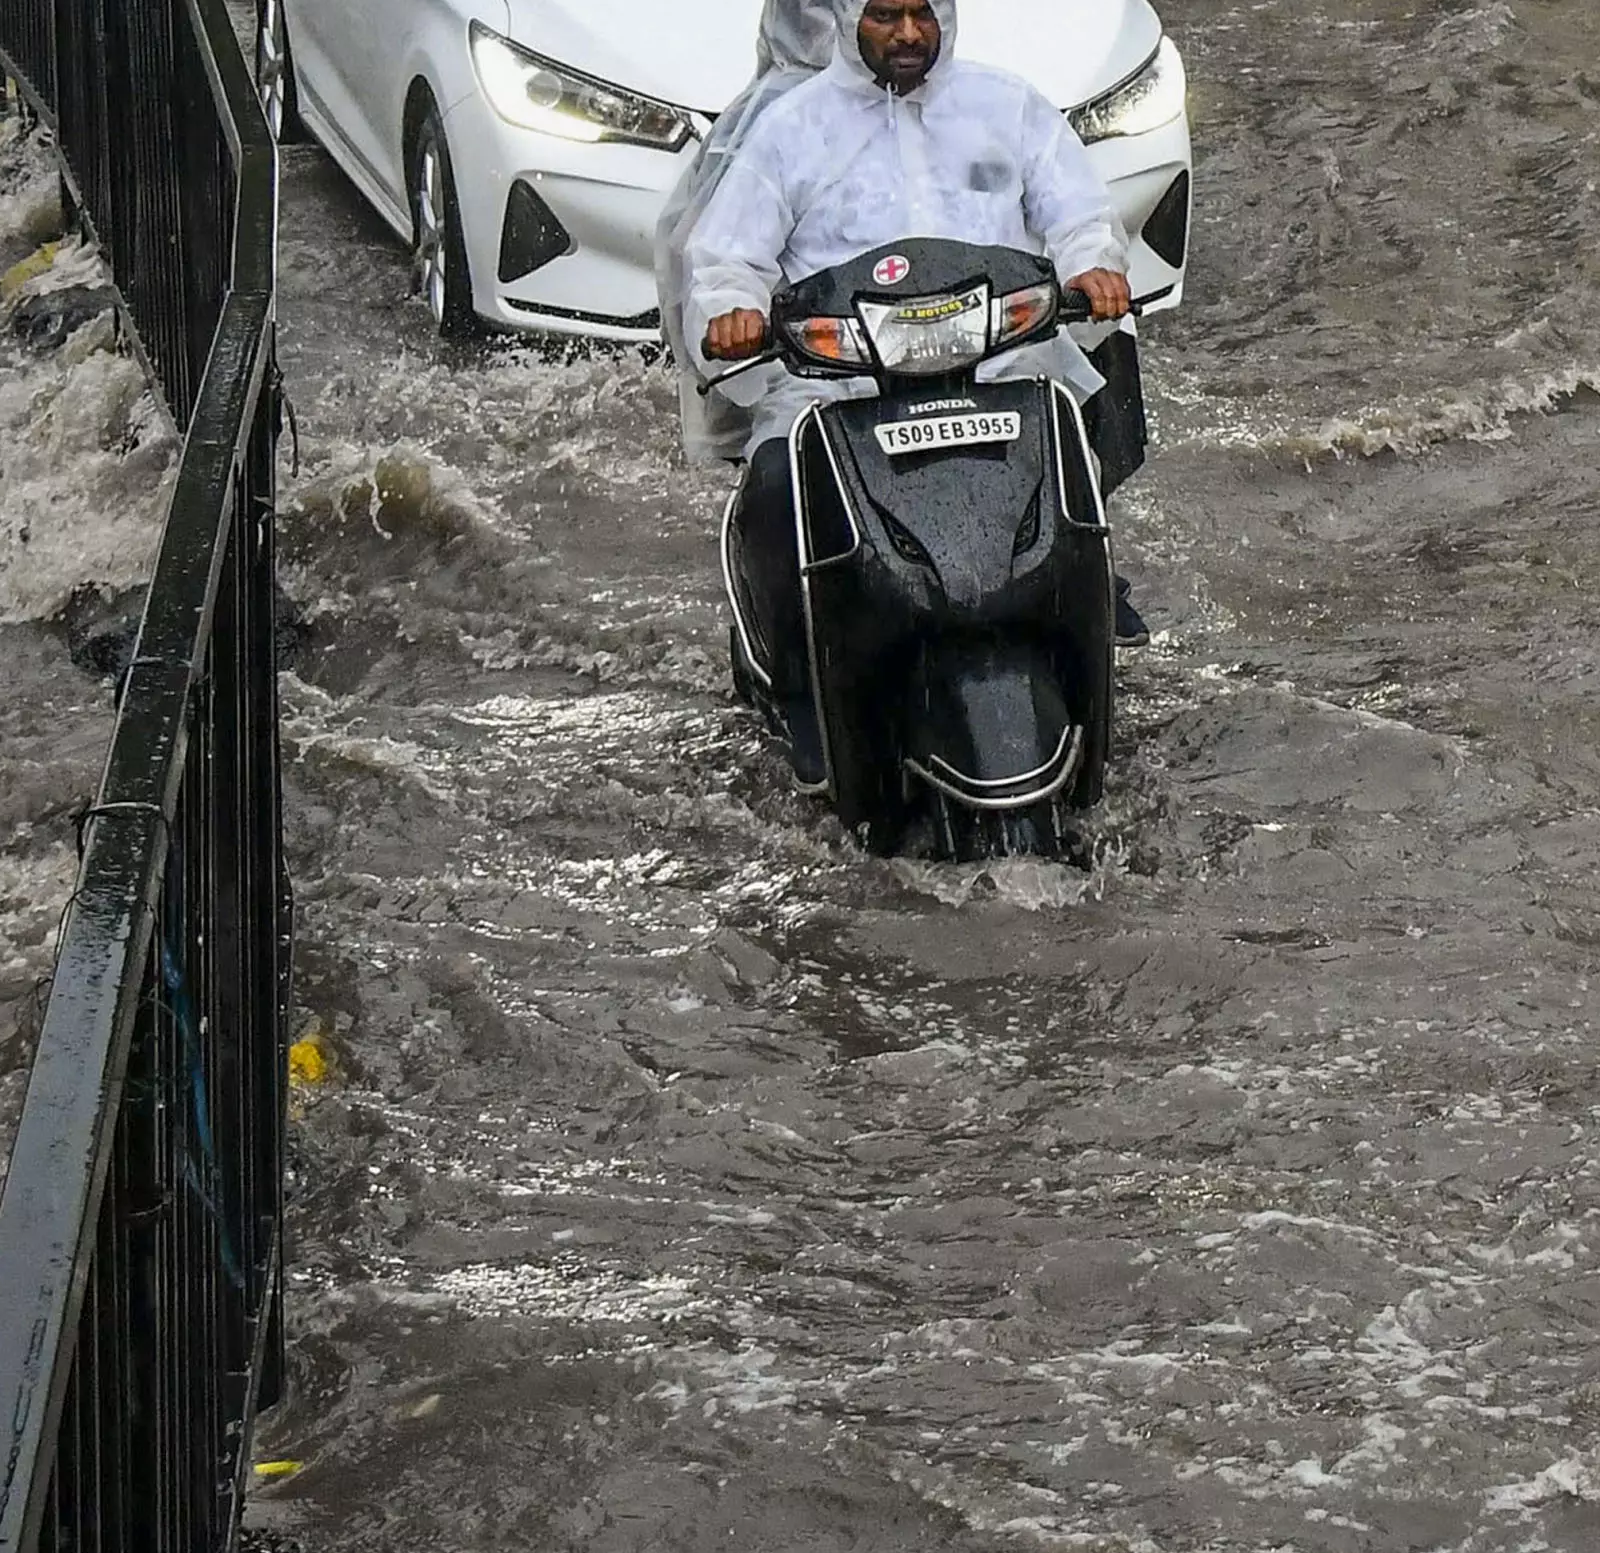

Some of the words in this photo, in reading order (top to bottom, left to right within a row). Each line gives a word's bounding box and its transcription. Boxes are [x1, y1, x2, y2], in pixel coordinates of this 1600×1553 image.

[916, 300, 963, 318] MOTORS
[908, 398, 977, 415] HONDA
[884, 423, 934, 447] TS09
[938, 421, 965, 441] EB
[966, 417, 1014, 437] 3955
